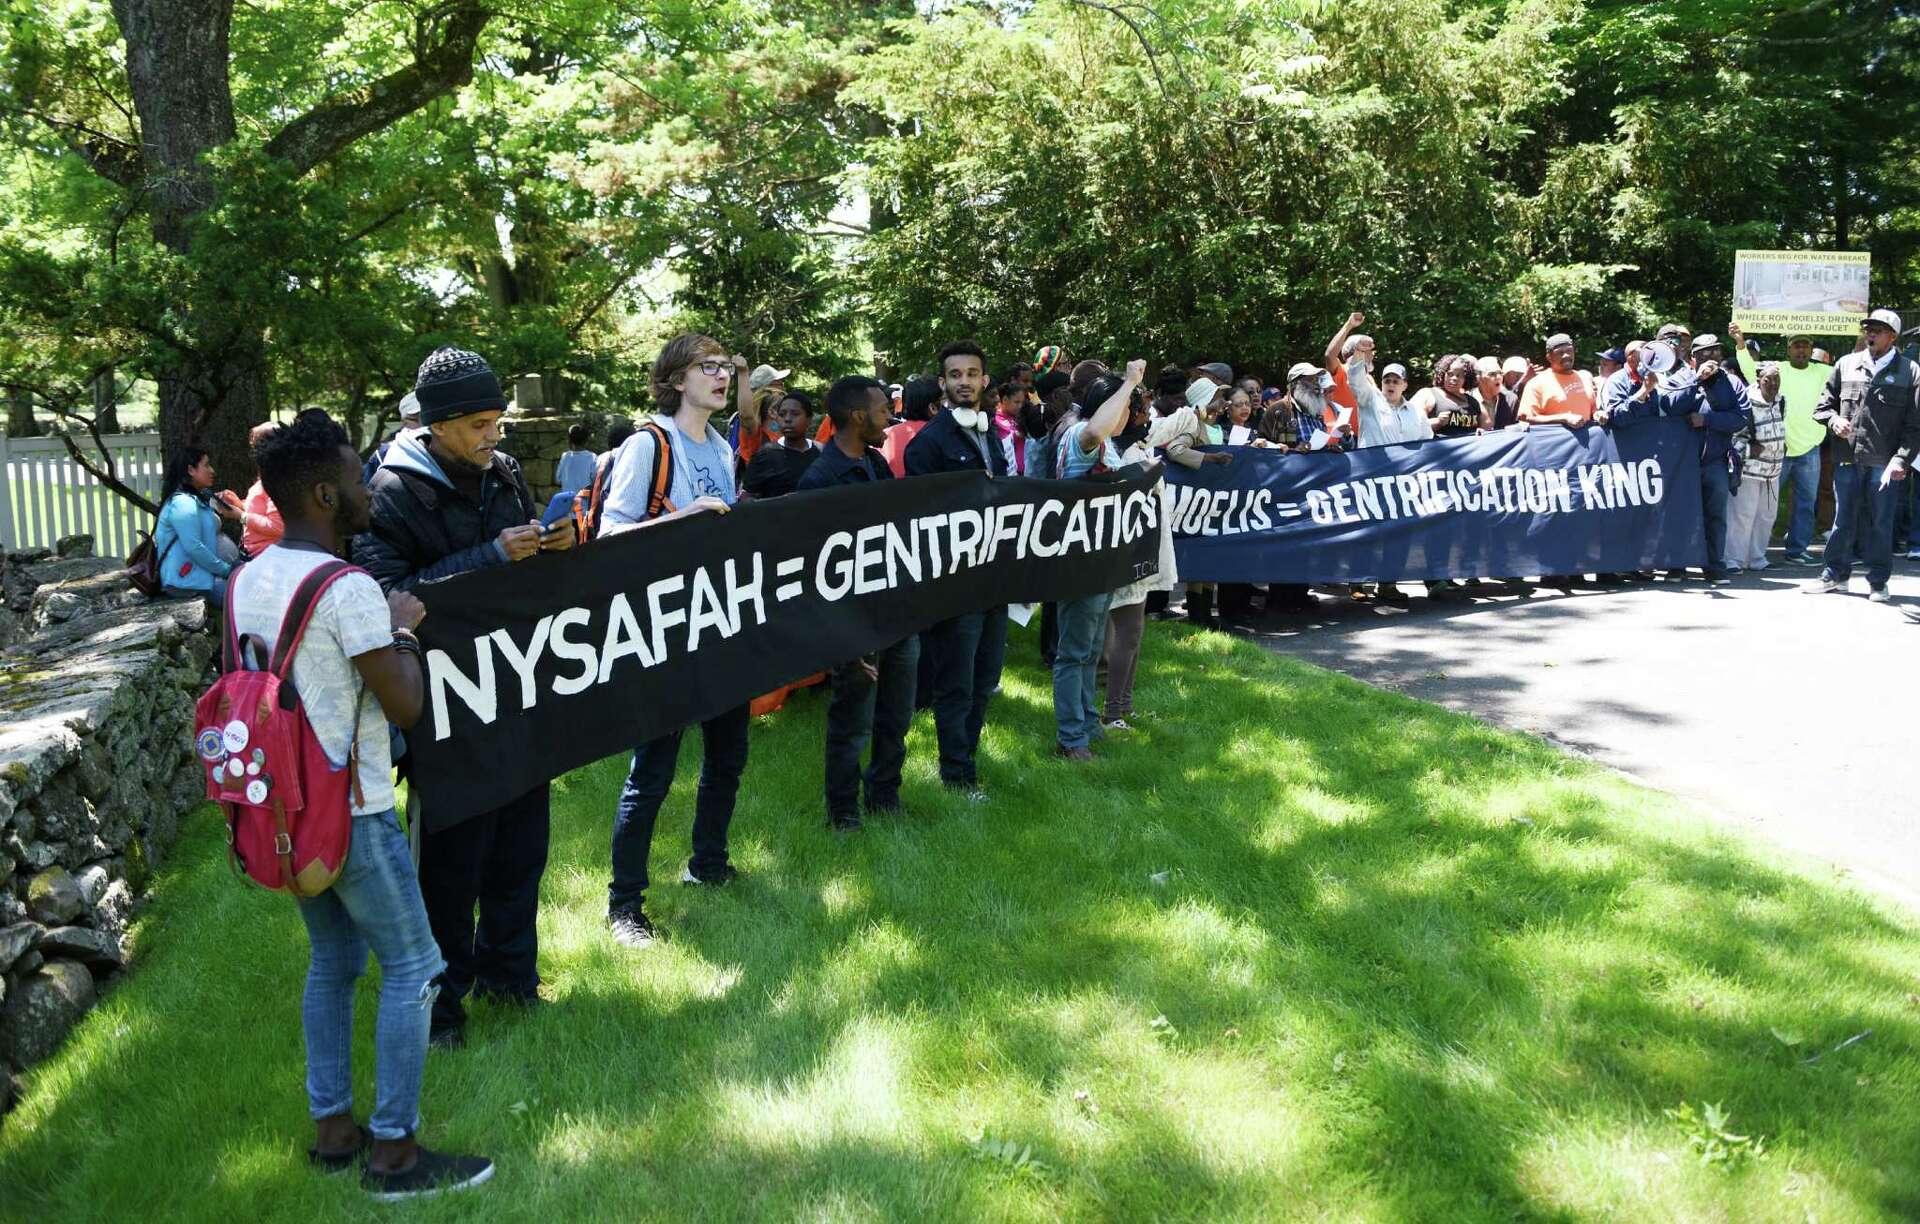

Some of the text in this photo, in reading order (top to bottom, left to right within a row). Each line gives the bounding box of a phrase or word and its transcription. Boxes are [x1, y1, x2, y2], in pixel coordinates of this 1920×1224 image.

[1787, 323, 1812, 331] GOLD
[1814, 324, 1849, 332] FAUCET
[1828, 315, 1861, 323] DRINKS
[1166, 483, 1272, 536] MOELIS
[1306, 466, 1571, 526] GENTRIFICATION
[1577, 458, 1664, 510] KING
[426, 551, 766, 741] NYSAFAH
